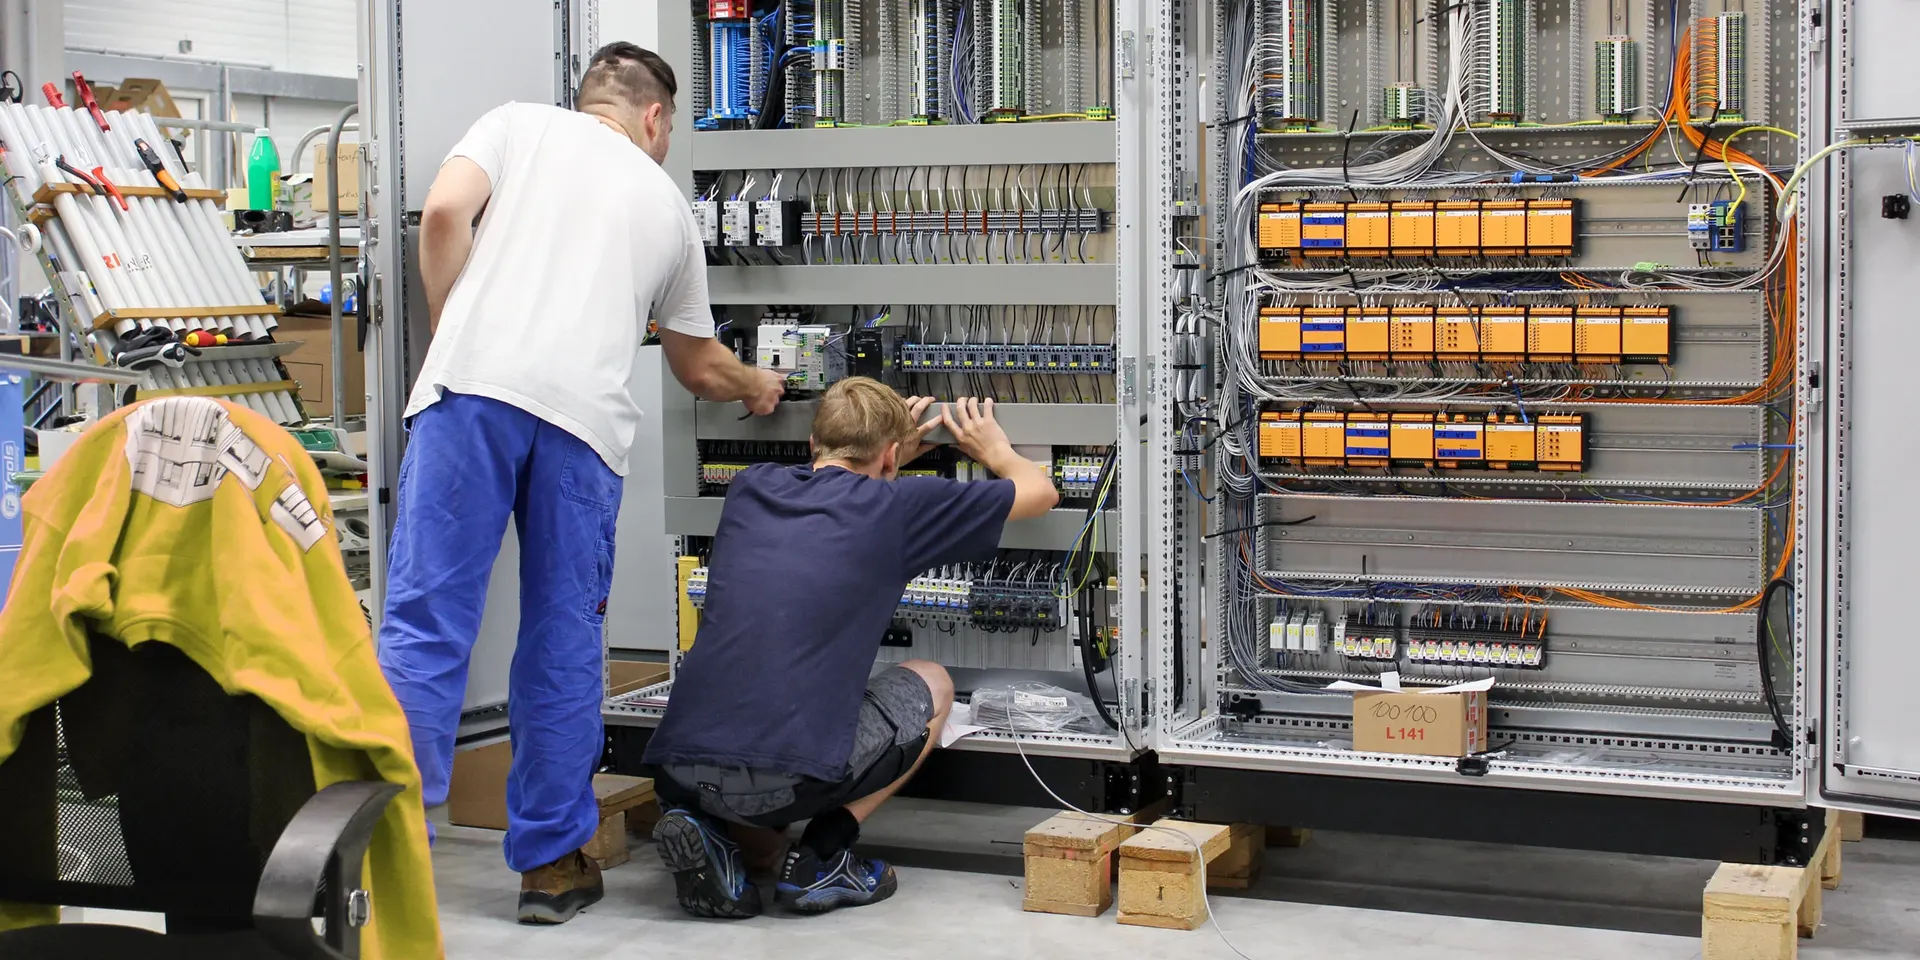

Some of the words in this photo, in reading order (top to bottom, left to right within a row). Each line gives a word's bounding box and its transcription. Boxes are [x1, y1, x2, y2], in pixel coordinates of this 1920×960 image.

[1369, 701, 1400, 720] 100
[1404, 704, 1437, 723] 100
[1386, 727, 1395, 739] L
[1398, 727, 1424, 740] 141
